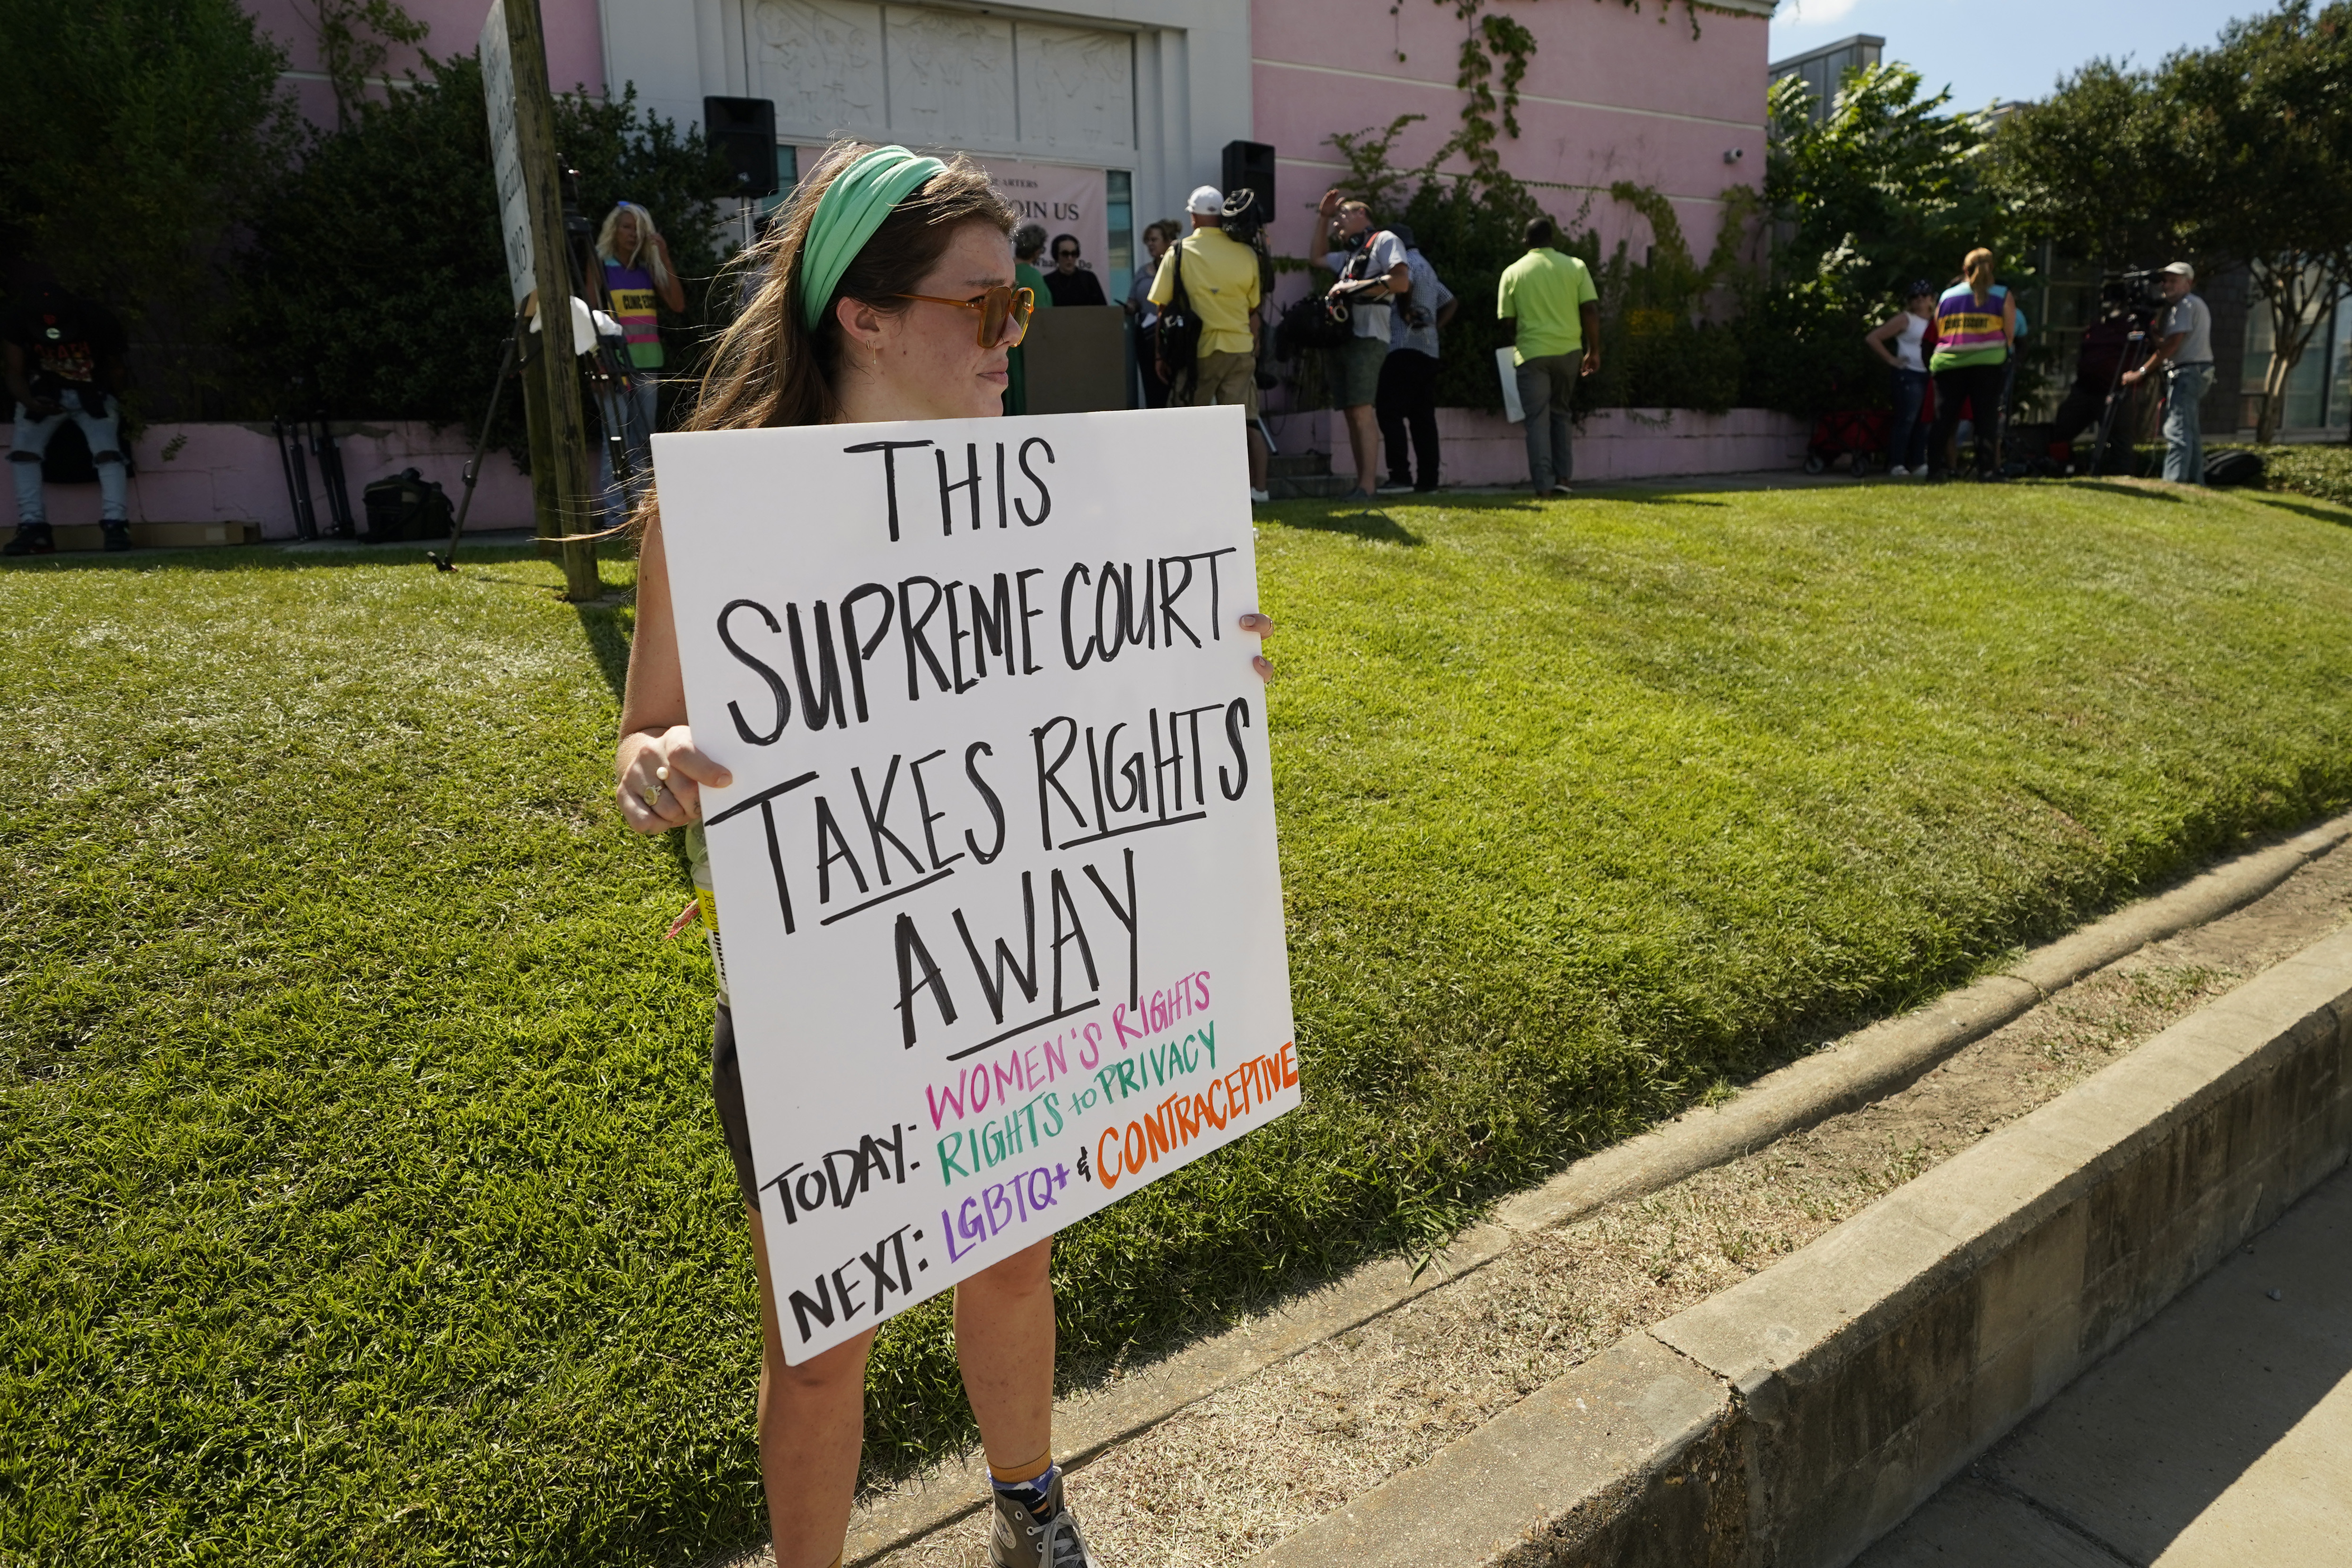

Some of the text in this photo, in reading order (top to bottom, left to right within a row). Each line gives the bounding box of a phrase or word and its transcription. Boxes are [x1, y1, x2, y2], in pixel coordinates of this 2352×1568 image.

[1008, 199, 1079, 220] OIN US
[1079, 259, 1092, 269] Do
[843, 438, 1055, 542] THIS
[717, 547, 1236, 746] SUPREME COURT
[704, 697, 1250, 934] TAKES RIGHTS
[893, 847, 1138, 1049] AWAY
[759, 1020, 1216, 1225] TODAY: RIGHTS to PRIVACY
[925, 970, 1211, 1131] WOMEN'S RIGHTS
[788, 1041, 1299, 1344] NEXT: LGBTQ+ & CONTRACEPTIVE
